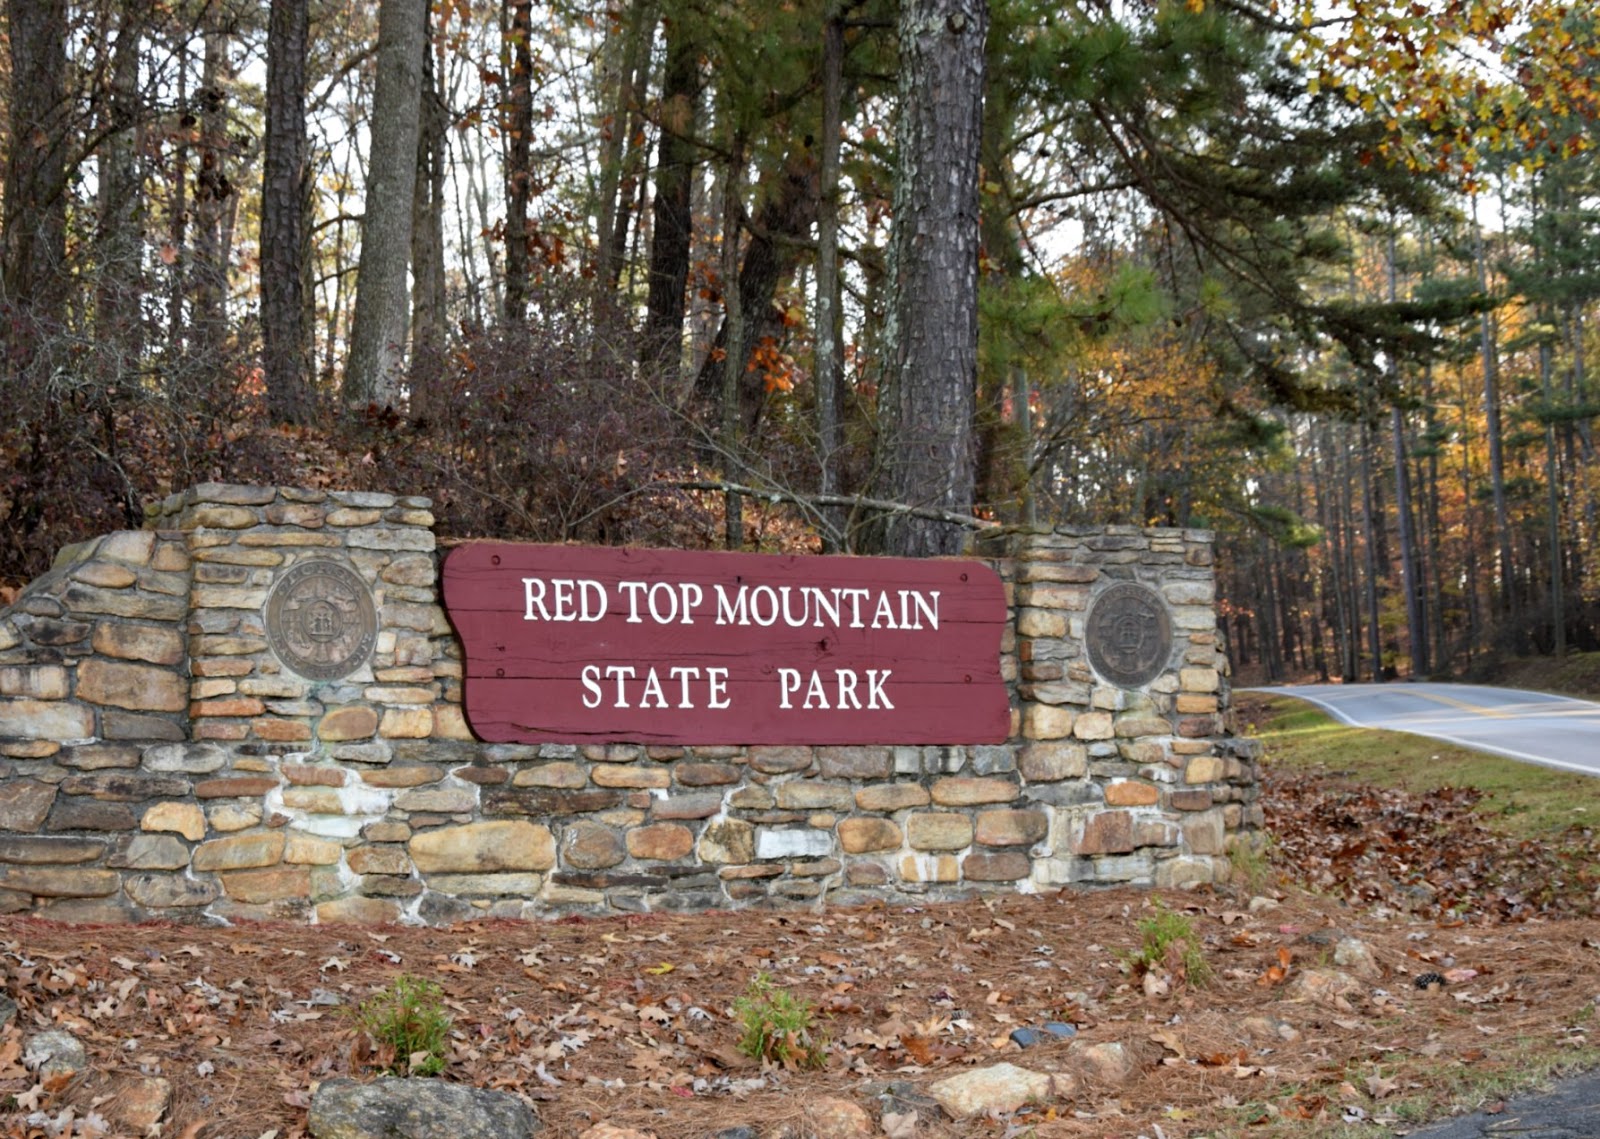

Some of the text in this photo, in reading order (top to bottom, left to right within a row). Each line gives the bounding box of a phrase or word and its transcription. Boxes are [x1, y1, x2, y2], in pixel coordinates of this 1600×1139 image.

[521, 577, 941, 631] RED TOP MOUNTAIN
[581, 664, 895, 711] STATE PARK
